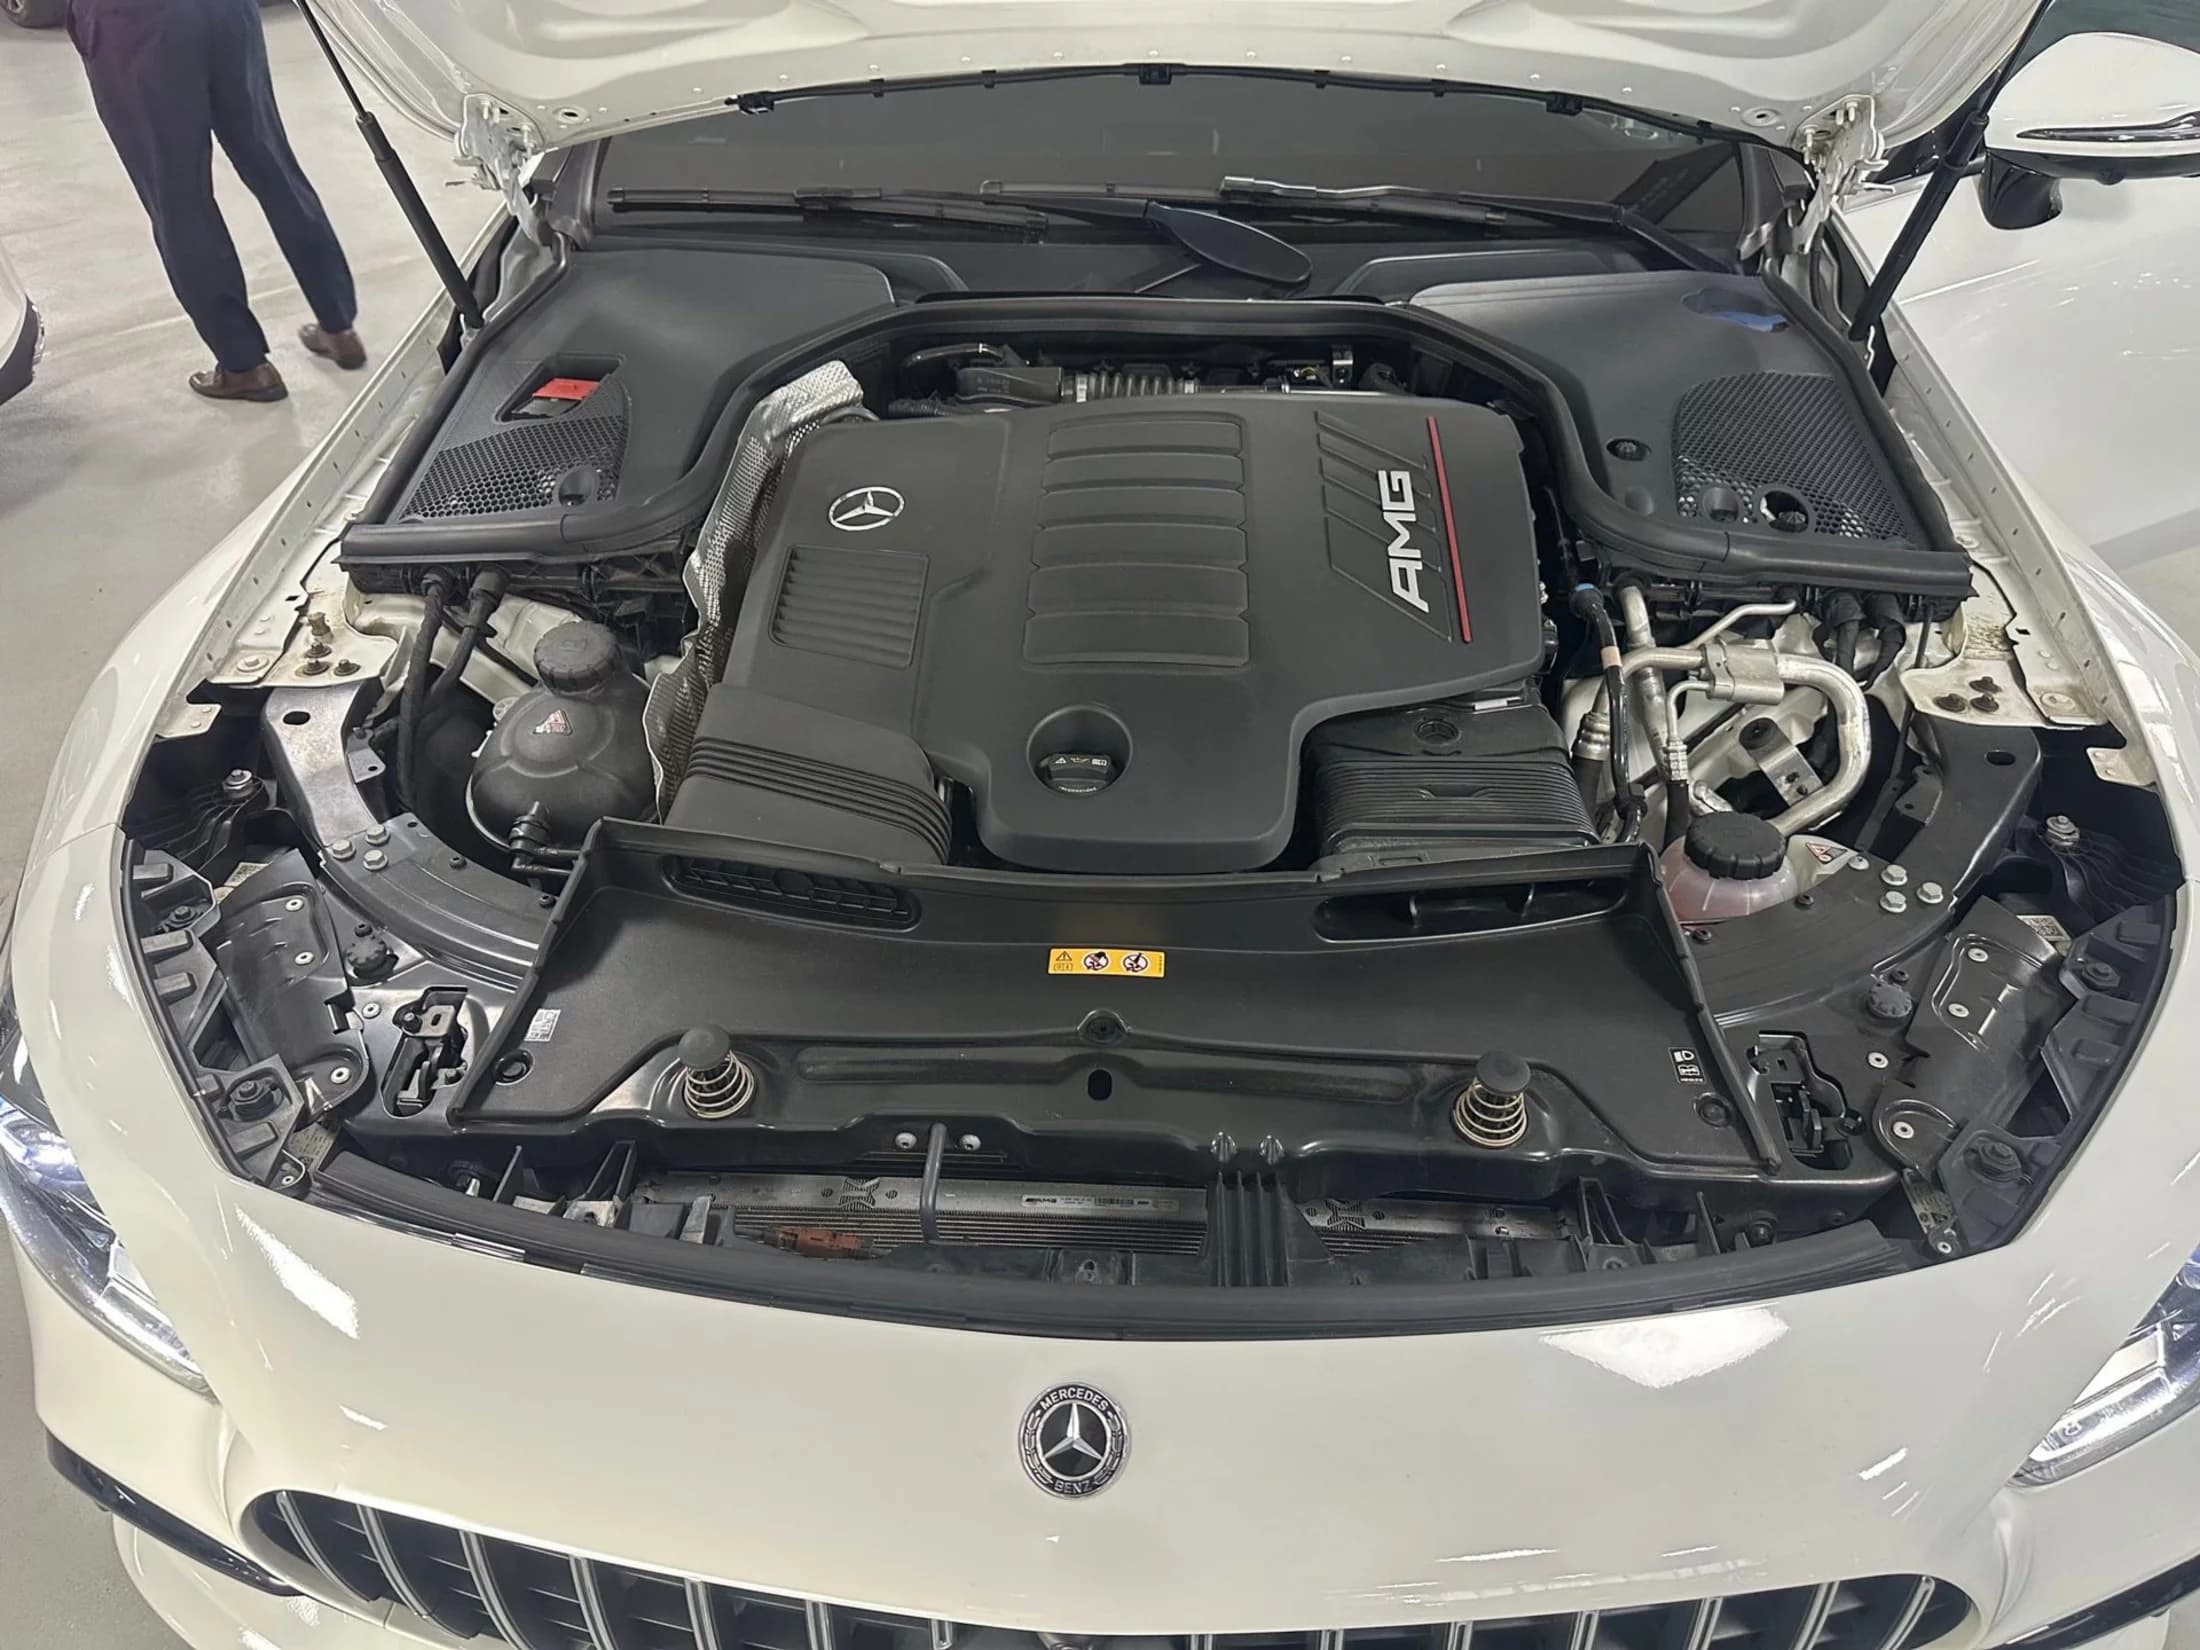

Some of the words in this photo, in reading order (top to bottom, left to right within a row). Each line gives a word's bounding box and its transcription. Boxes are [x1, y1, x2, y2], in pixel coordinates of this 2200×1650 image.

[1377, 469, 1429, 614] AMG
[1039, 1387, 1109, 1411] MERCEDES
[1054, 1481, 1093, 1494] BENZ
